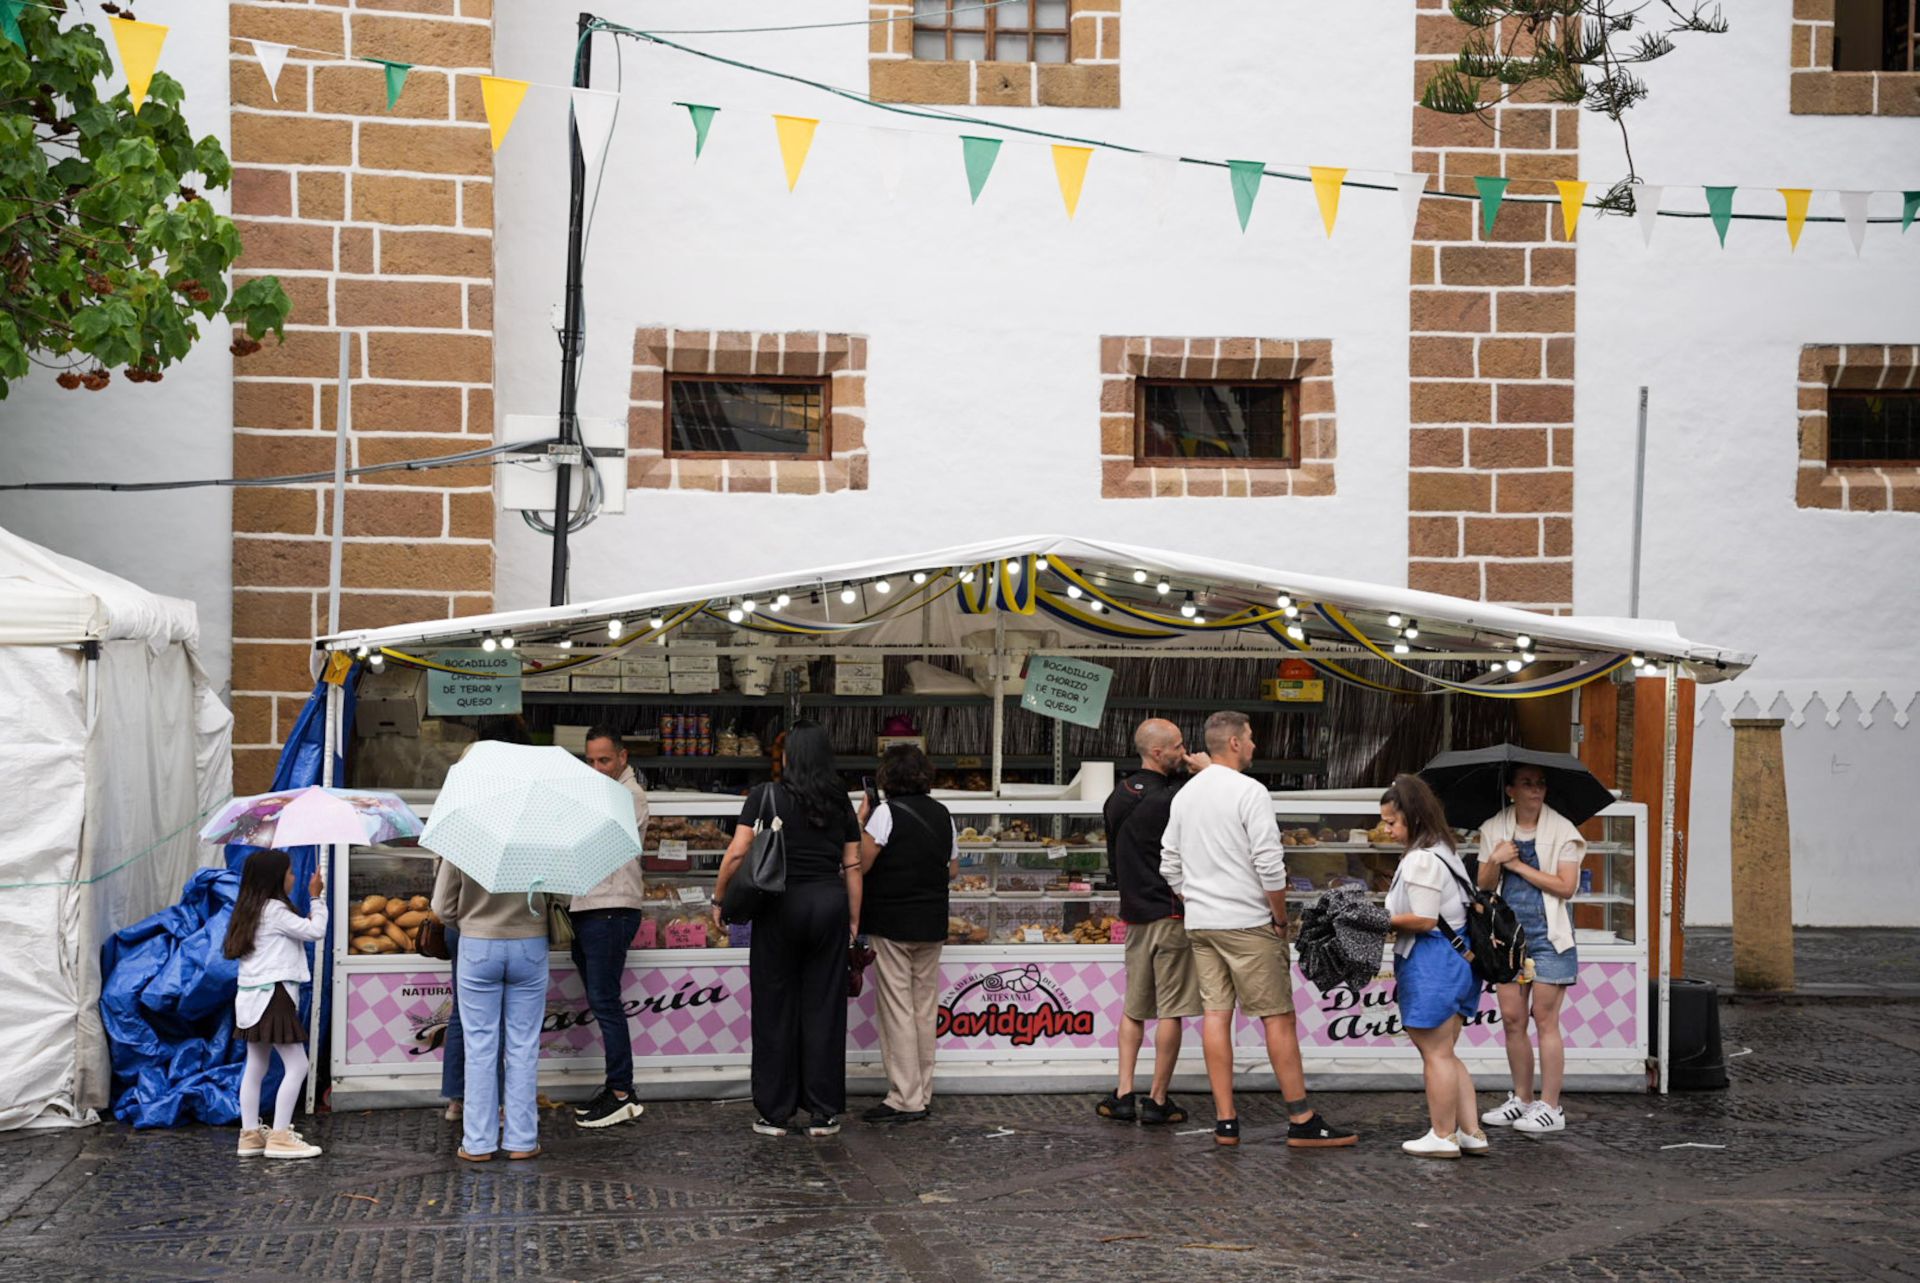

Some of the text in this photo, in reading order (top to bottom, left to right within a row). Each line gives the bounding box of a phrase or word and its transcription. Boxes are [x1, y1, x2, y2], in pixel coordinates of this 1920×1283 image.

[445, 658, 508, 668] BOCADILLOS
[1043, 660, 1100, 682] BOCADILLOS
[1046, 674, 1088, 691] CHORIZO
[443, 684, 503, 694] DE TEROR Y
[1051, 687, 1079, 702] TEROR
[457, 697, 493, 708] QUESO
[1044, 699, 1077, 714] QUESO
[402, 986, 453, 996] NATURA
[980, 993, 1034, 1003] ARTESANAL
